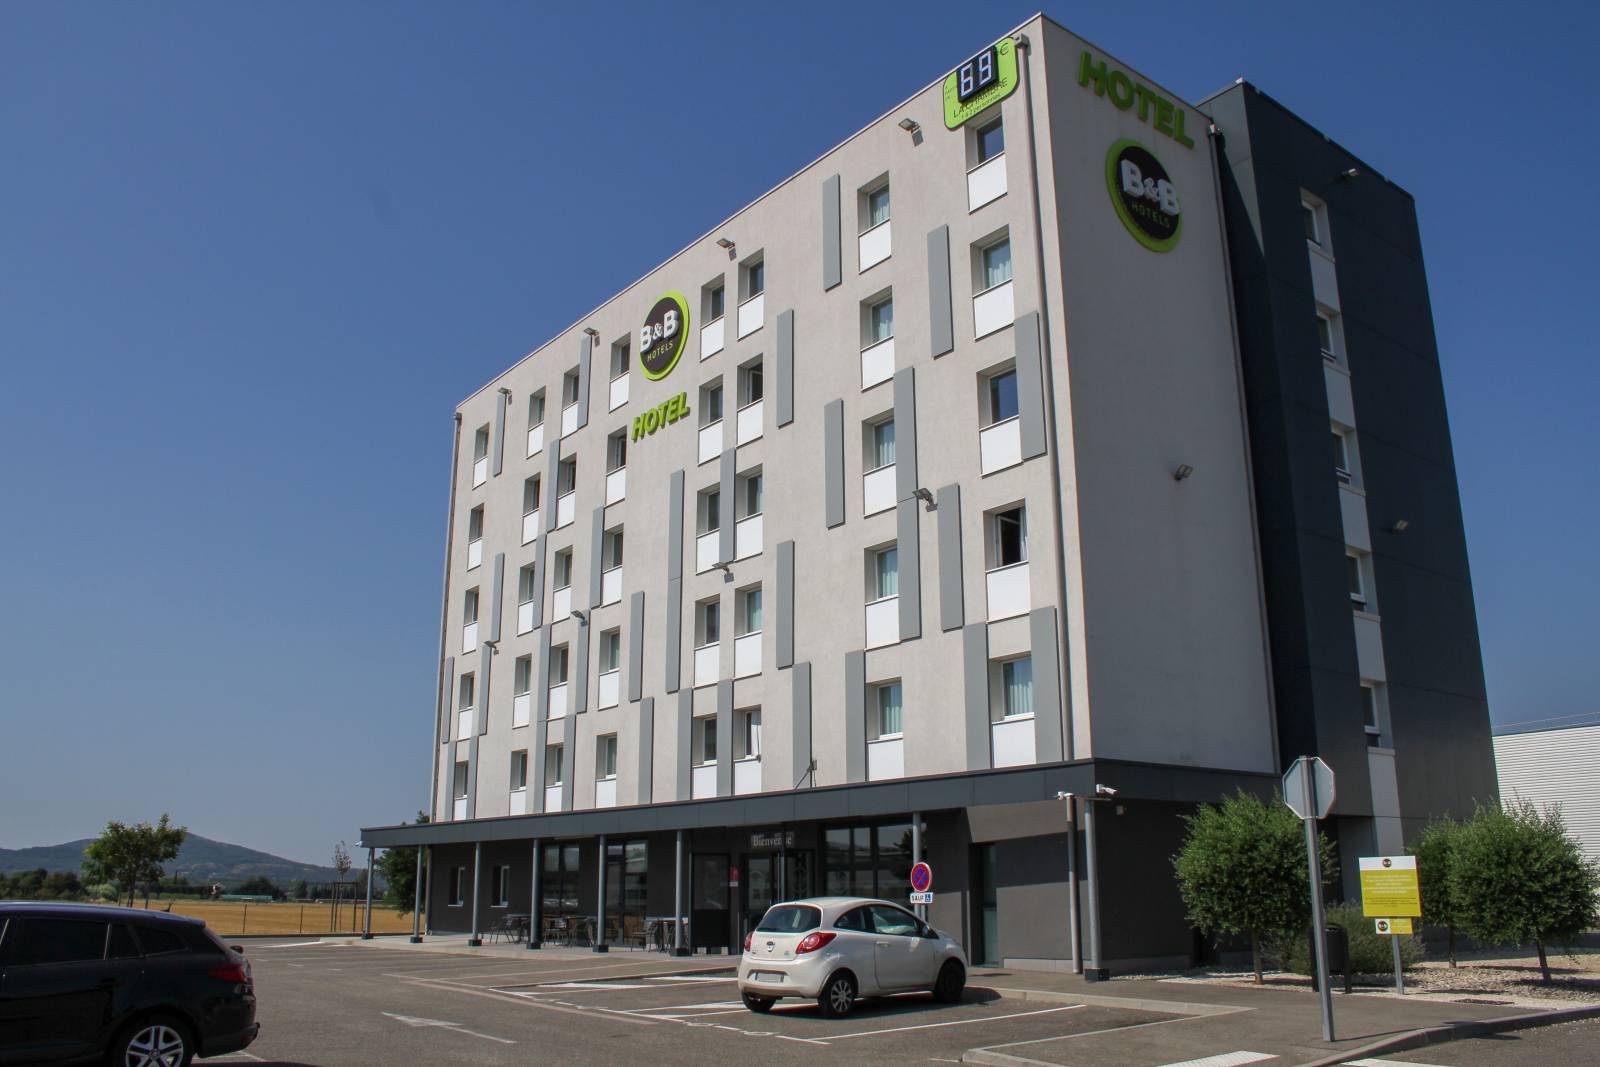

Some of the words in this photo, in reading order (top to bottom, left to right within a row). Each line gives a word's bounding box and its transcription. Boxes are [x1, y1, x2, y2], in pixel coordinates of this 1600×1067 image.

[1078, 51, 1194, 149] HOTEL
[1121, 159, 1179, 216] B&B
[1131, 203, 1171, 229] HOTELS
[640, 309, 678, 353] B&B
[647, 340, 673, 362] HOTELS
[631, 392, 690, 442] HOTEL
